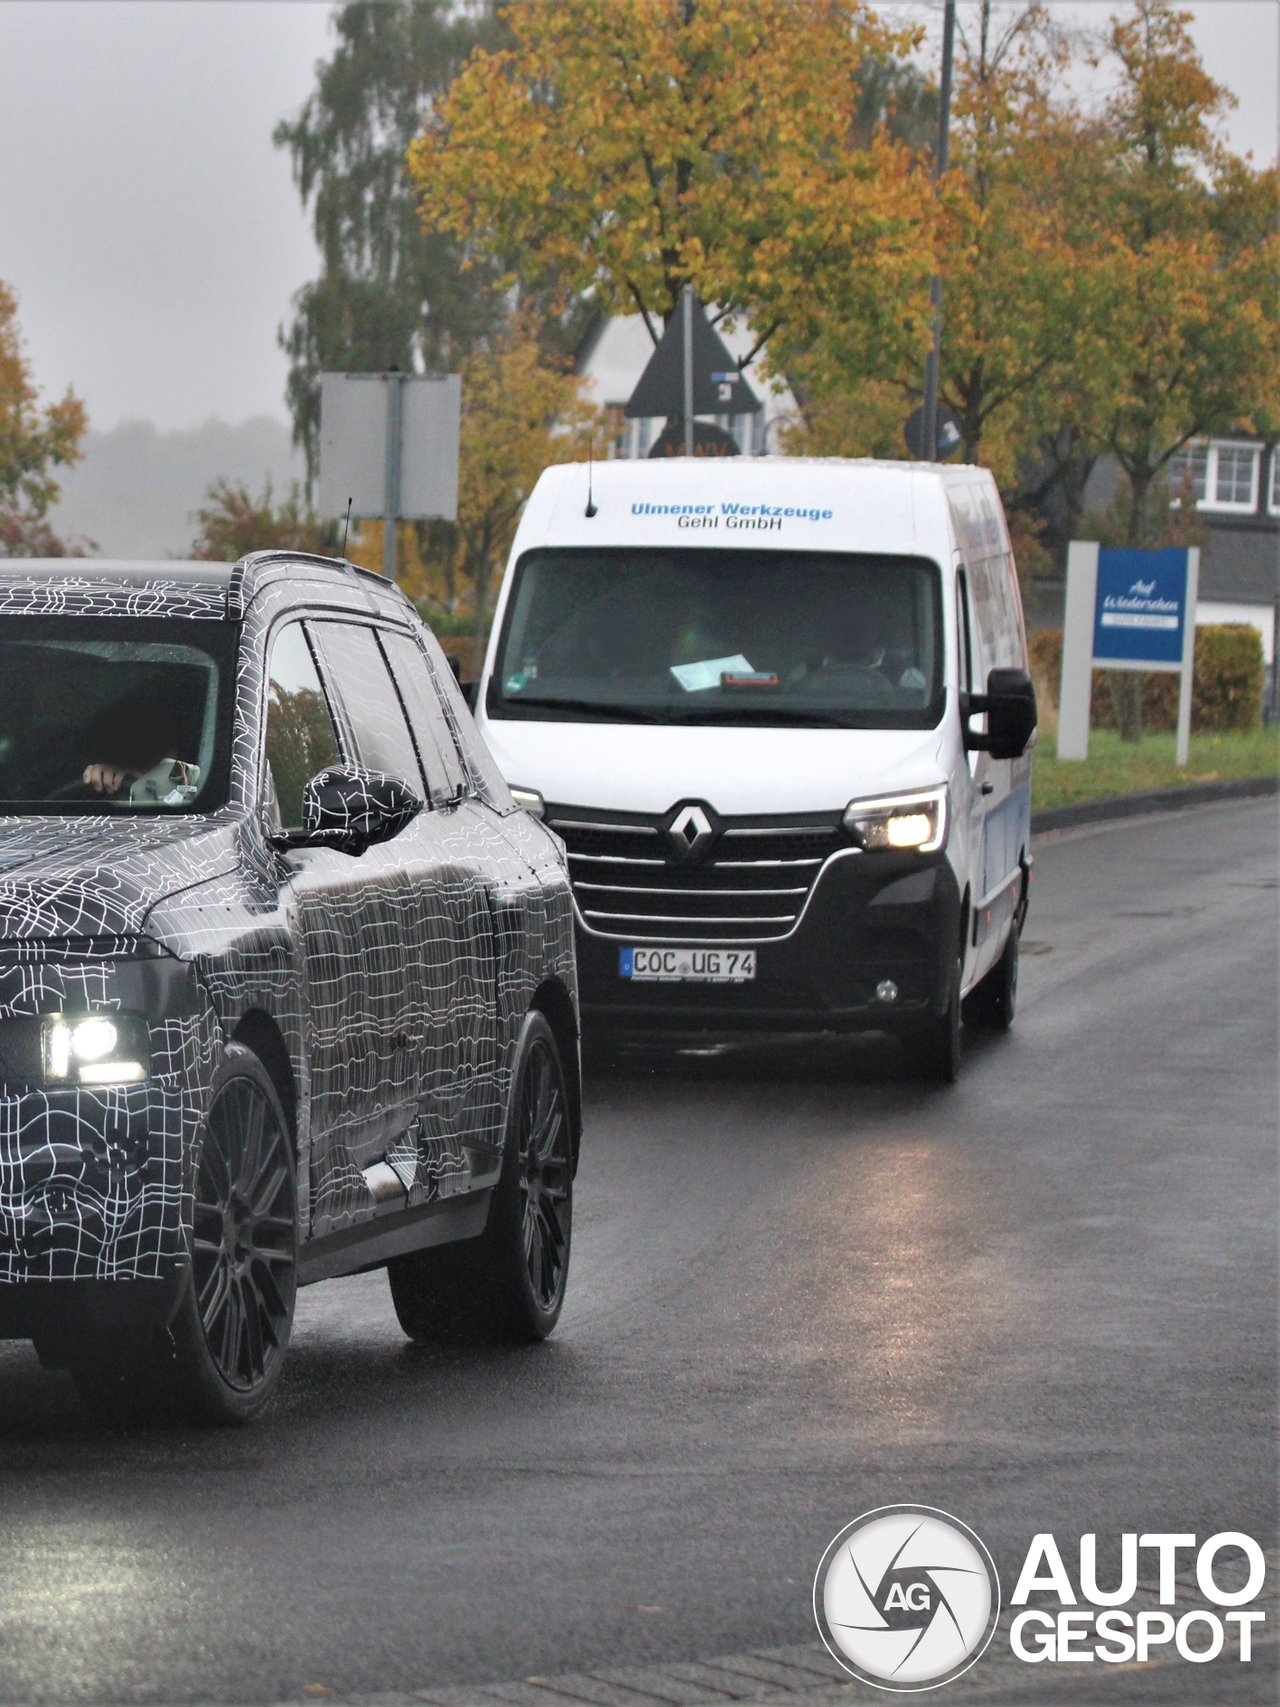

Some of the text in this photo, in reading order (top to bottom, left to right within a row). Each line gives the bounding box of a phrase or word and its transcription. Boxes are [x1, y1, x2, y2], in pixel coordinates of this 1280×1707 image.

[631, 502, 834, 521] Ulmener Werkzeuge
[677, 515, 782, 530] Gehl GmbH
[1128, 579, 1157, 597] Auf
[1103, 594, 1179, 610] Wiedersehen
[634, 951, 753, 975] COC UG 74
